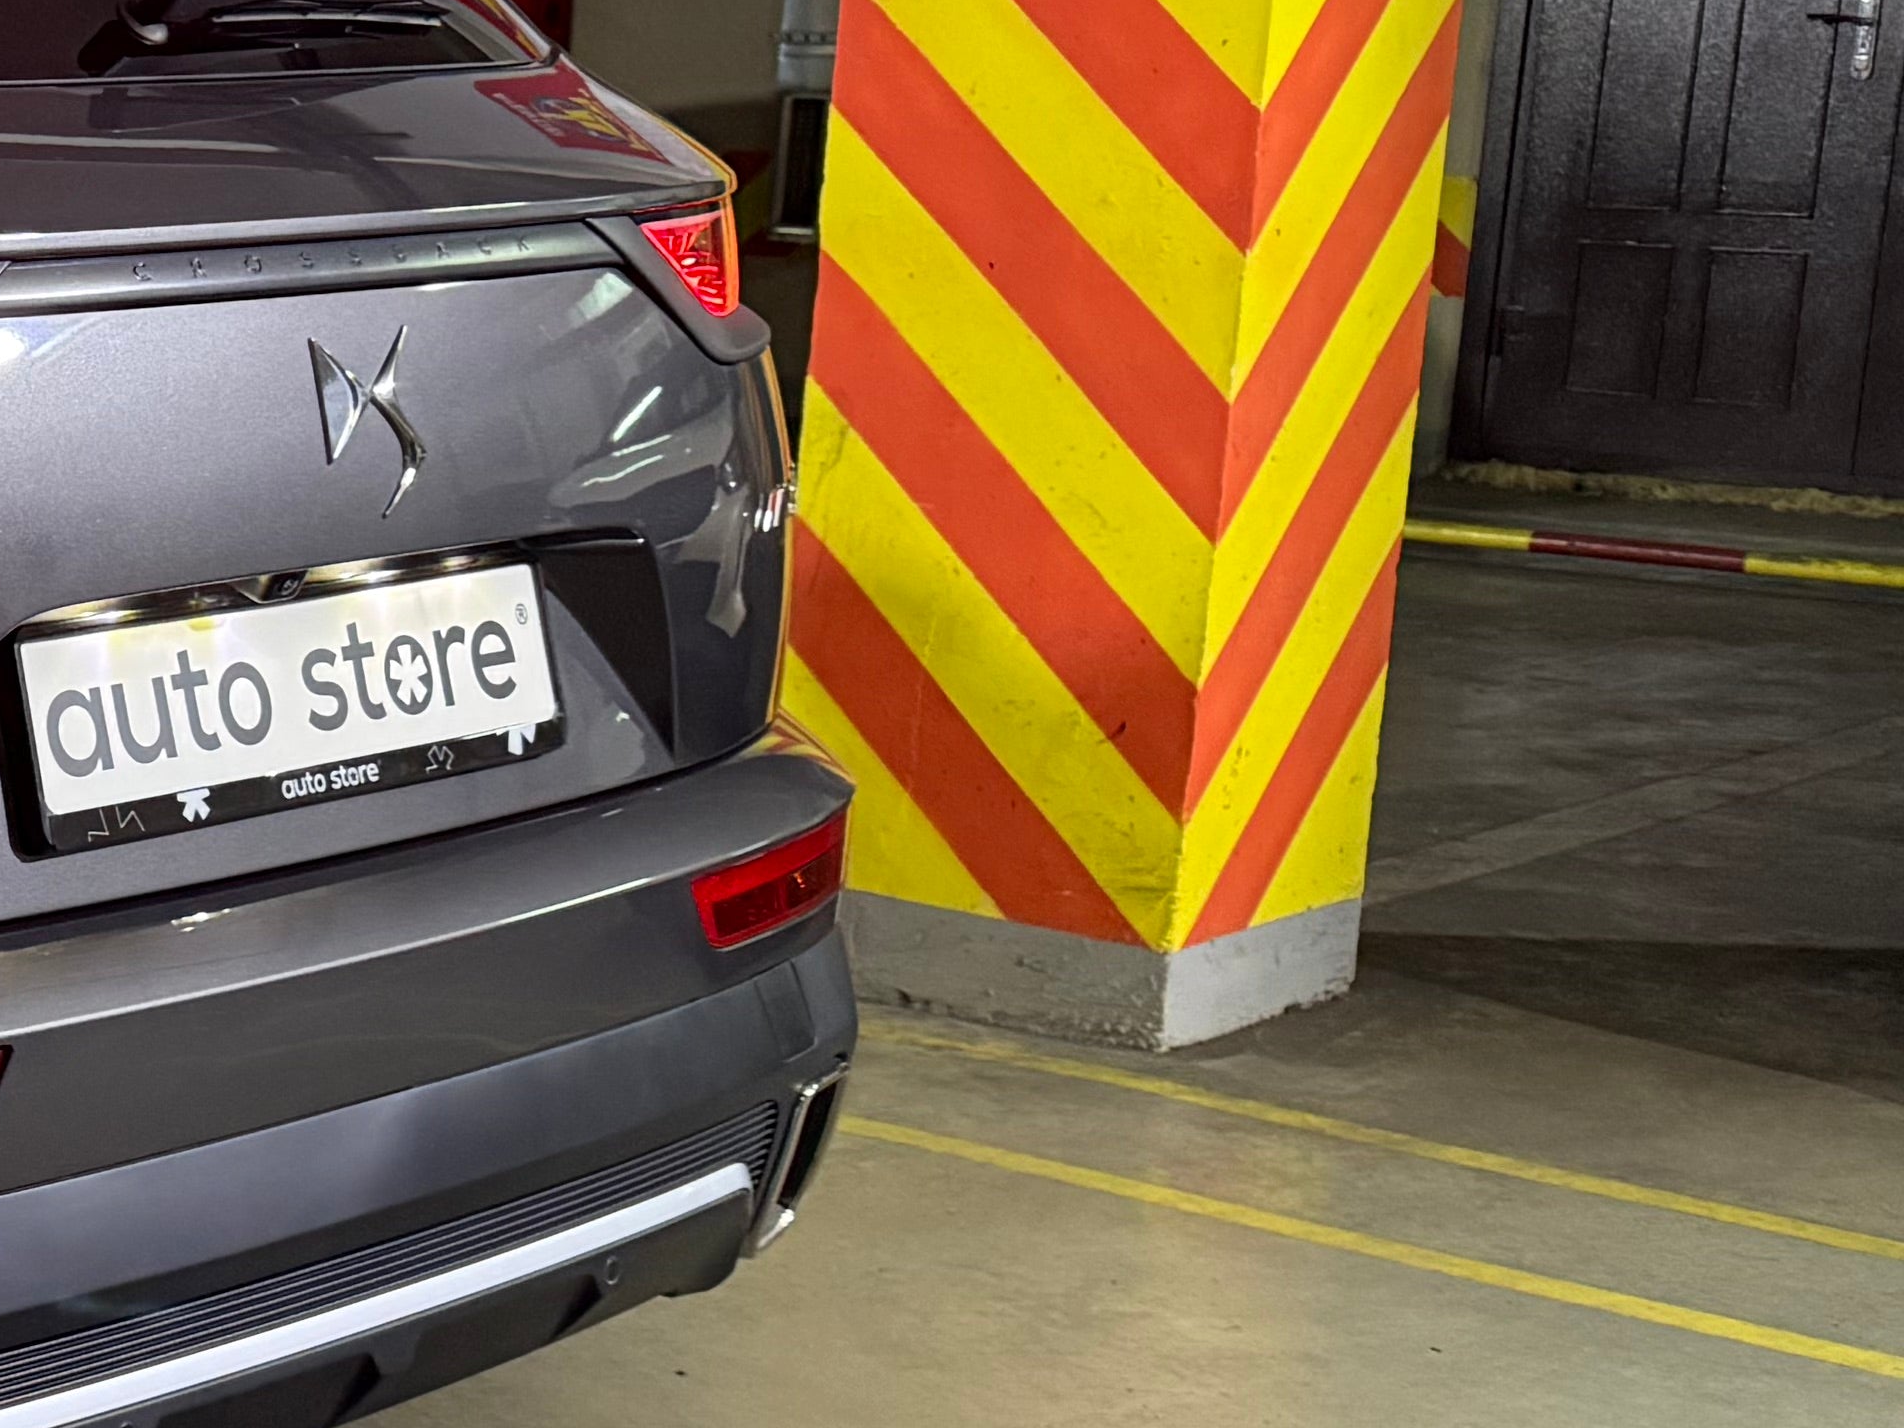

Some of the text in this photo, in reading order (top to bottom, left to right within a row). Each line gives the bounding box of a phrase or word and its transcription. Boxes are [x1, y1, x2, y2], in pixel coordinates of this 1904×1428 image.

[47, 650, 272, 778] auto
[281, 762, 380, 800] auto store
